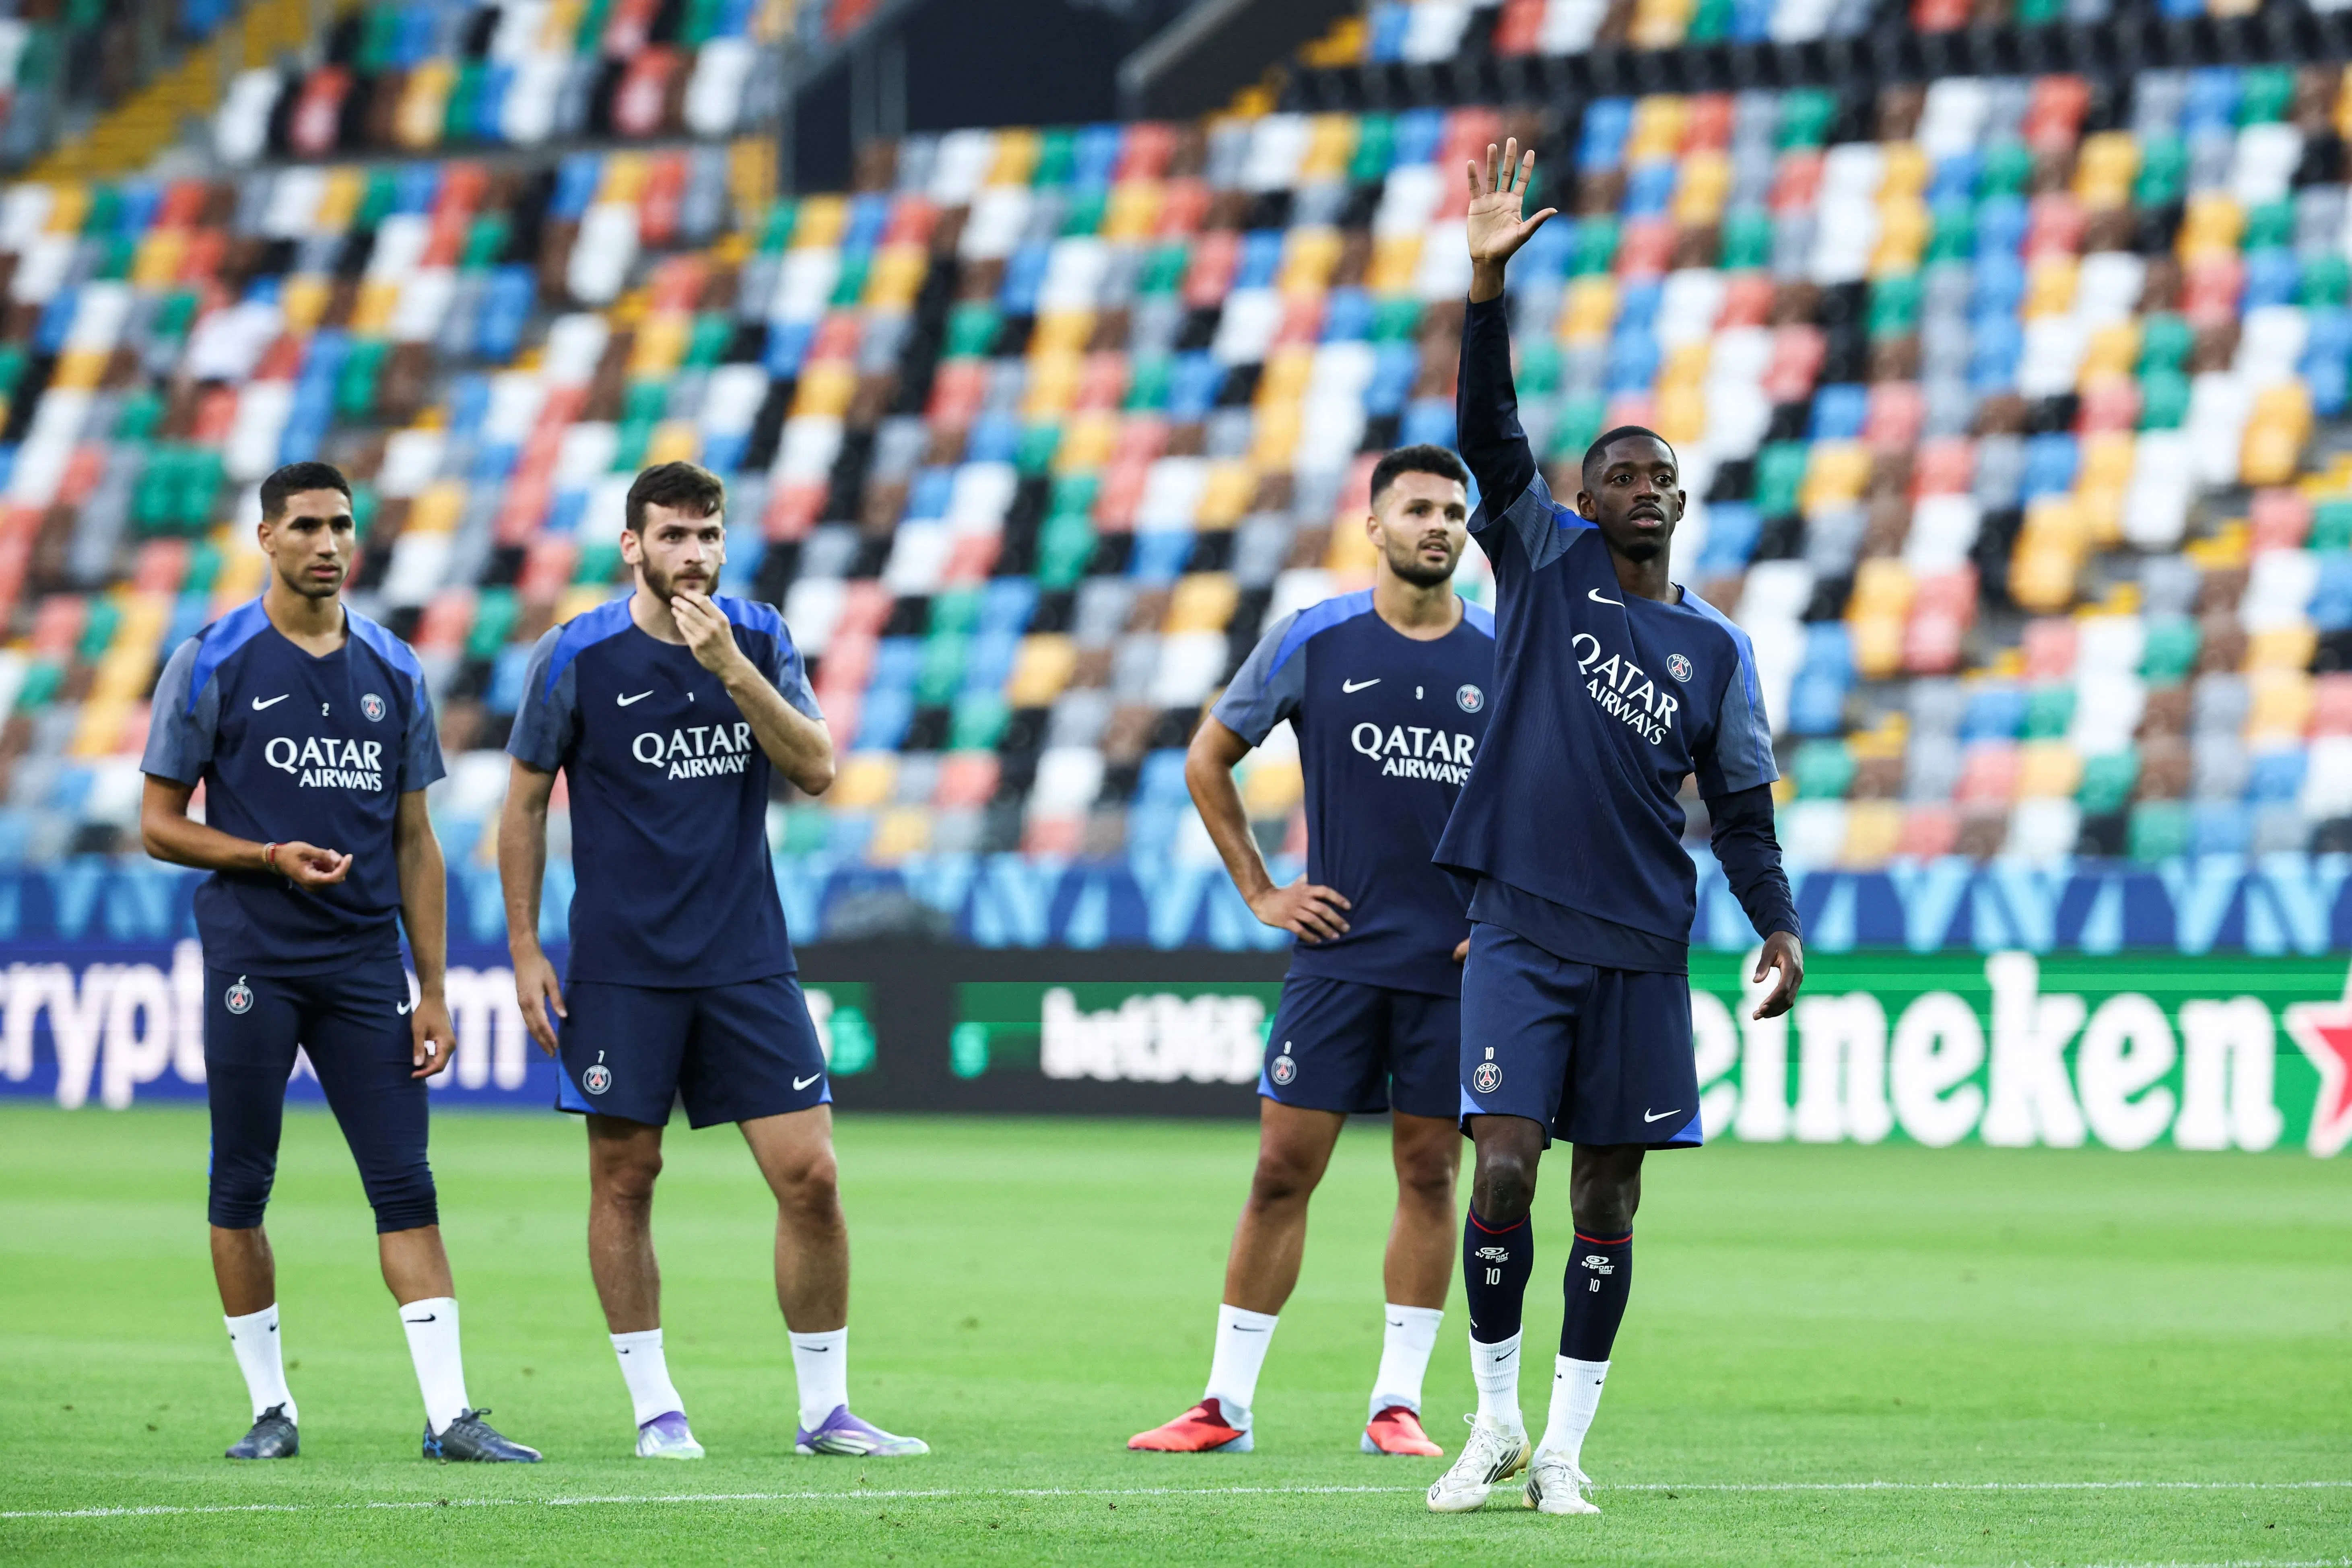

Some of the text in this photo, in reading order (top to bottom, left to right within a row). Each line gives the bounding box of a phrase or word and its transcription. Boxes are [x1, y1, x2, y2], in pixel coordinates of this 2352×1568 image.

[1672, 655, 1689, 667] PARIS
[1572, 633, 1678, 729] QATAR
[322, 703, 329, 716] 2
[1586, 678, 1667, 745] AIRWAYS
[265, 737, 382, 774] QATAR
[632, 722, 752, 768] QATAR
[1351, 722, 1475, 767] QATAR
[668, 754, 752, 780] AIRWAY
[299, 769, 382, 791] AIRWAYS
[1485, 1047, 1494, 1060] 10
[1478, 1064, 1497, 1073] PARIS
[1486, 1267, 1501, 1285] 10
[1589, 1278, 1600, 1292] 10
